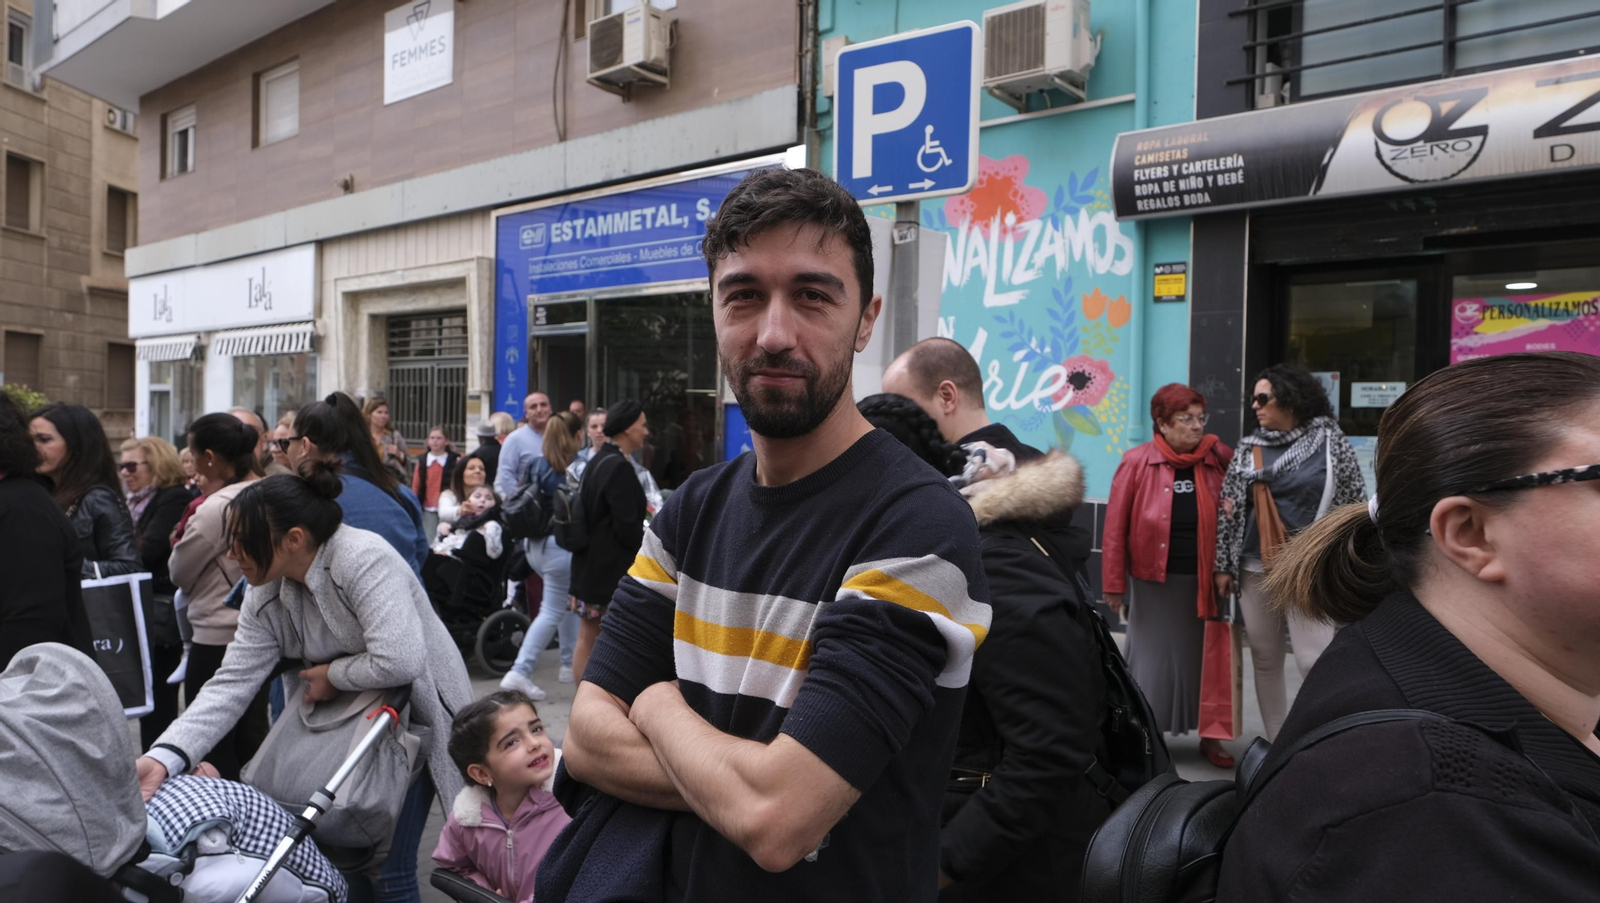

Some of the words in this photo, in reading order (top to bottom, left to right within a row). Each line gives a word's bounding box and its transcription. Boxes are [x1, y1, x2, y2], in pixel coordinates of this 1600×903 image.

[392, 35, 446, 70] FEMMES
[852, 60, 927, 179] P
[1136, 141, 1161, 151] ROPA
[1165, 132, 1208, 148] LABORAL
[1390, 139, 1473, 161] ZERO
[1134, 148, 1189, 166] CAMISETAS
[1134, 165, 1170, 181] FLYERS
[1172, 164, 1180, 176] Y
[1182, 153, 1245, 176] CARTELERÍA
[1135, 182, 1161, 197] ROPA
[1163, 180, 1177, 193] DE
[1179, 175, 1204, 192] NIÑO
[1206, 175, 1214, 188] Y
[1217, 169, 1245, 187] BEBÉ
[1136, 194, 1181, 211] REGALOS
[1183, 192, 1212, 206] BODA
[551, 202, 690, 244] ESTAMMETAL,
[529, 259, 579, 275] Instalaciones
[580, 250, 632, 269] Comerciales
[639, 244, 679, 261] Muebles
[680, 241, 694, 257] de
[1482, 299, 1599, 320] PERSONALIZAMOS
[1525, 343, 1556, 351] BODIES
